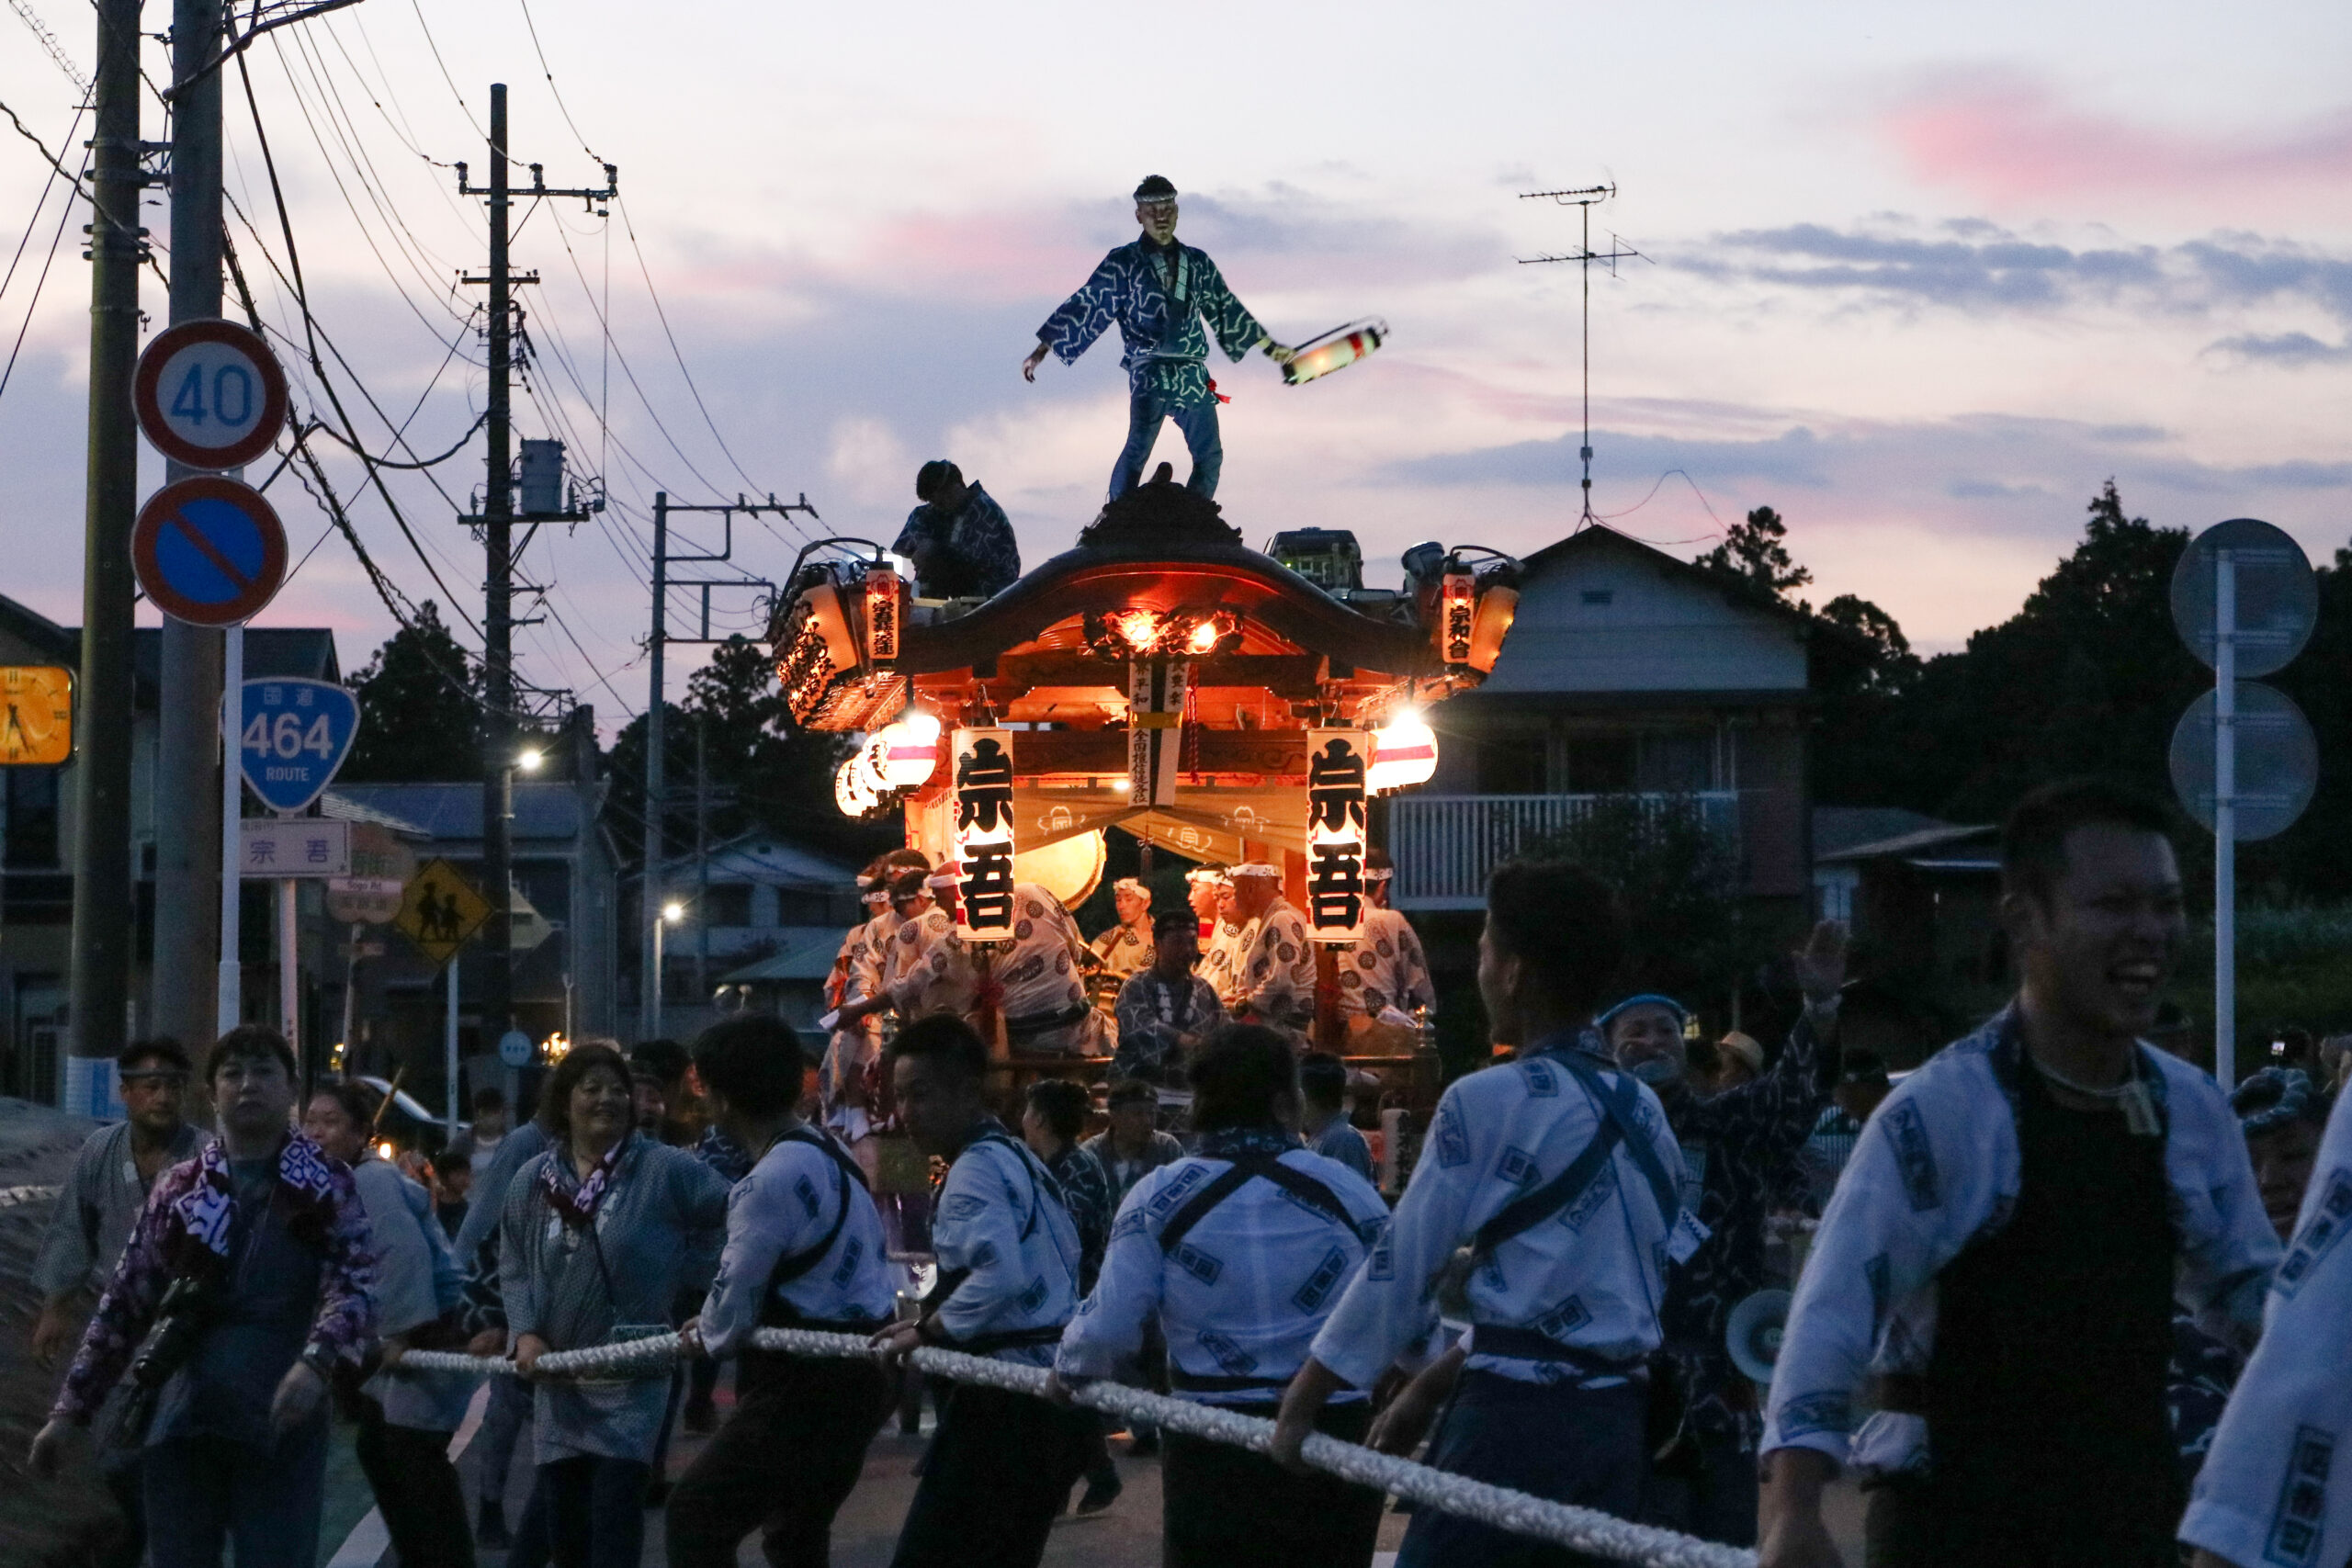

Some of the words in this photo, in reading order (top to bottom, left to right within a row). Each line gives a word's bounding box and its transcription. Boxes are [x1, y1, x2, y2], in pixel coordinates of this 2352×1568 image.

[171, 363, 253, 426] 40
[264, 686, 314, 706] 国道
[243, 713, 334, 760] 464
[266, 767, 311, 782] ROUTE
[249, 840, 332, 864] 宗吾
[957, 738, 1014, 931] 宗吾
[1308, 738, 1365, 931] 宗吾
